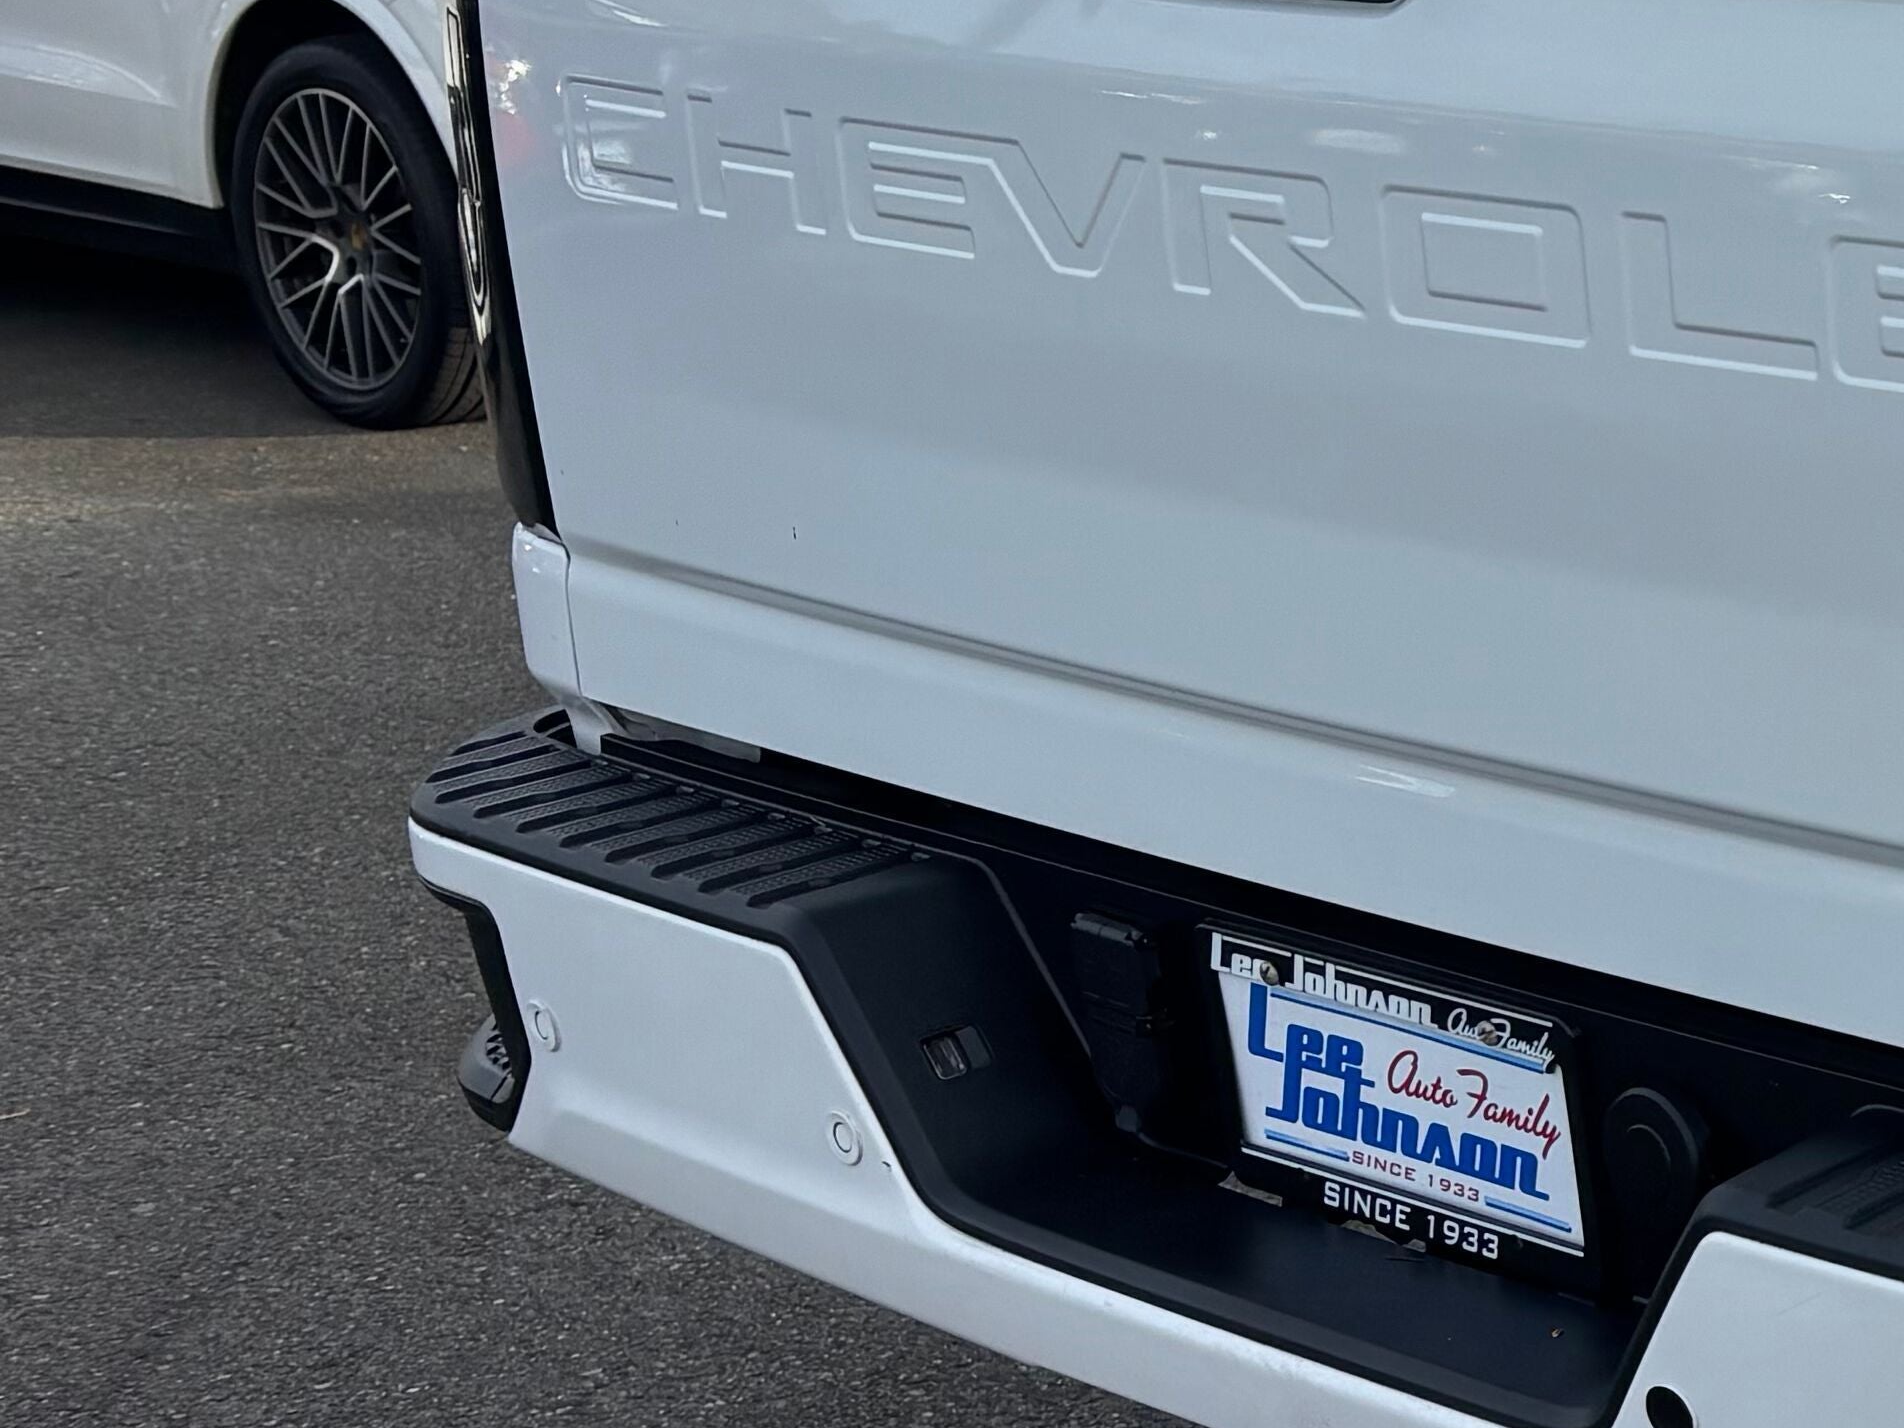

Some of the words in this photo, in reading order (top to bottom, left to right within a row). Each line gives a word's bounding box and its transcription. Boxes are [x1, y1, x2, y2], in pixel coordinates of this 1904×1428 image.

[1248, 982, 1364, 1080] Lee
[1285, 953, 1439, 1029] Johnson
[1488, 1018, 1555, 1074] Family
[1265, 1062, 1550, 1201] Johnson
[1387, 1049, 1458, 1109] Auto
[1456, 1068, 1562, 1161] Family
[1323, 1180, 1411, 1232] SINCE
[1426, 1214, 1500, 1261] 1933
[1351, 1150, 1417, 1182] SINCE
[1427, 1173, 1480, 1202] 1933
